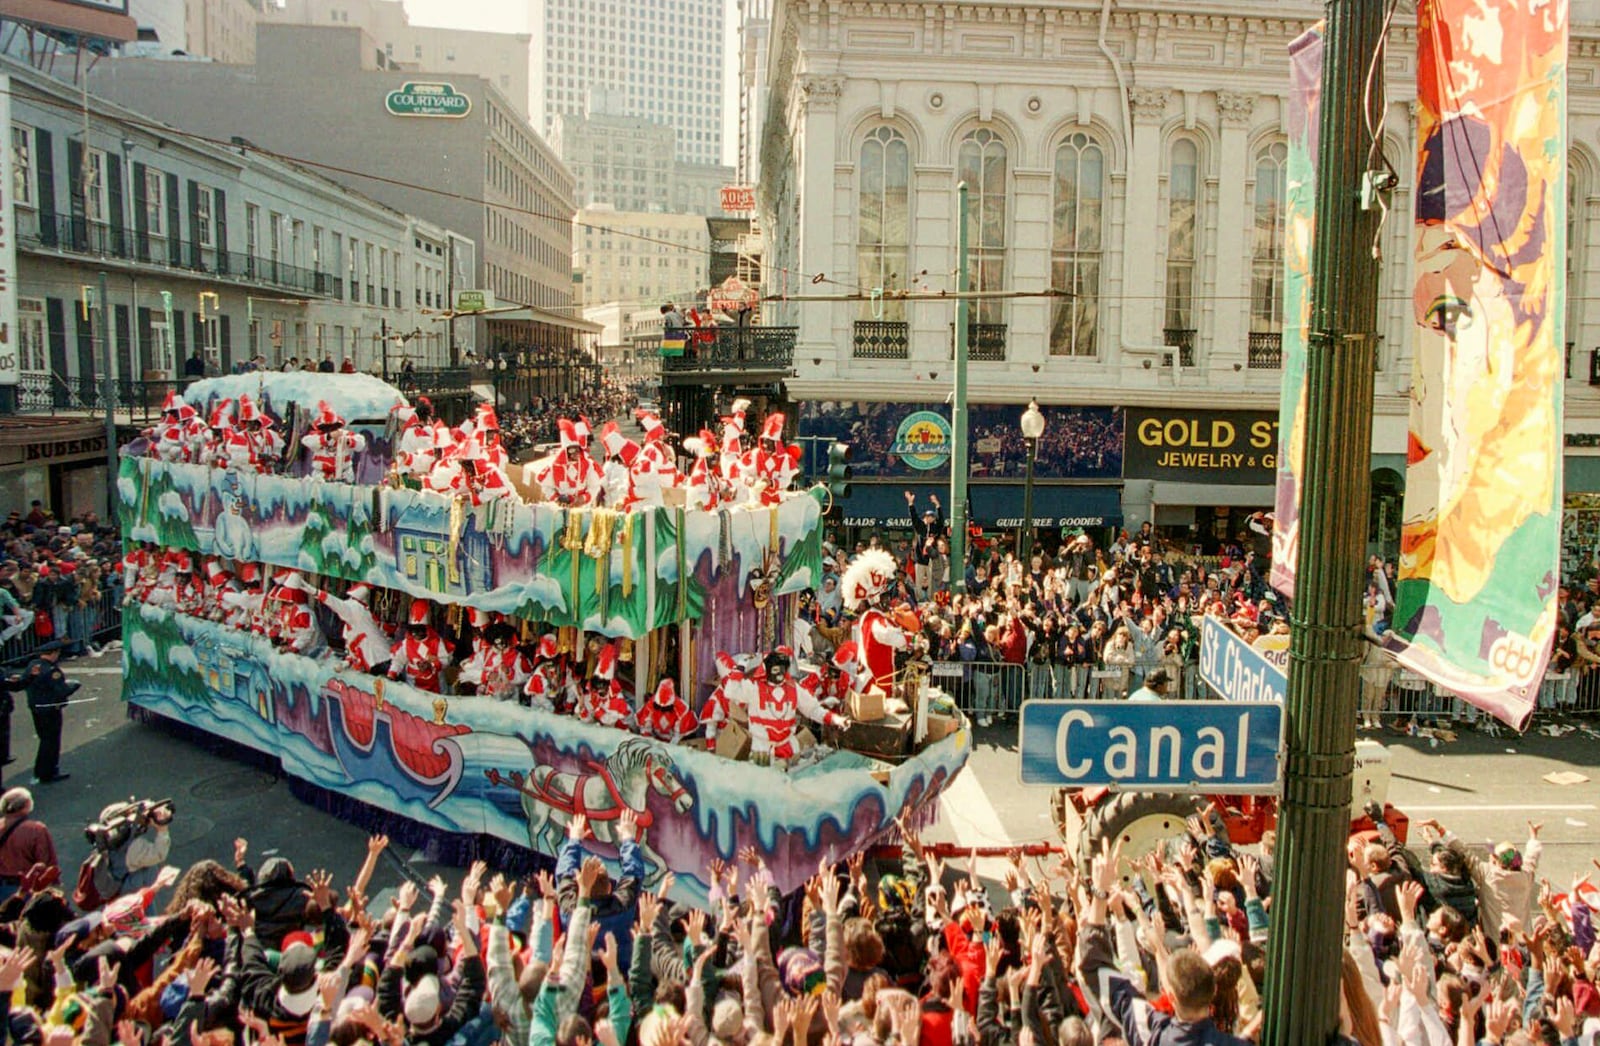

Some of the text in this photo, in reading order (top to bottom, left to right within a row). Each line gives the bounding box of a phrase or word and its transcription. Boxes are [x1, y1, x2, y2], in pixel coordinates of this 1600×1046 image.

[393, 94, 466, 107] COURTYARD
[1137, 418, 1236, 448] GOLD
[1157, 452, 1244, 468] JEWELRY
[1247, 456, 1256, 467] &
[842, 517, 876, 527] ALADS
[996, 518, 1025, 527] GUILT
[1058, 517, 1103, 527] GOODIES
[1202, 622, 1222, 686] St.
[1263, 649, 1288, 666] BIG
[1054, 709, 1251, 780] Canal
